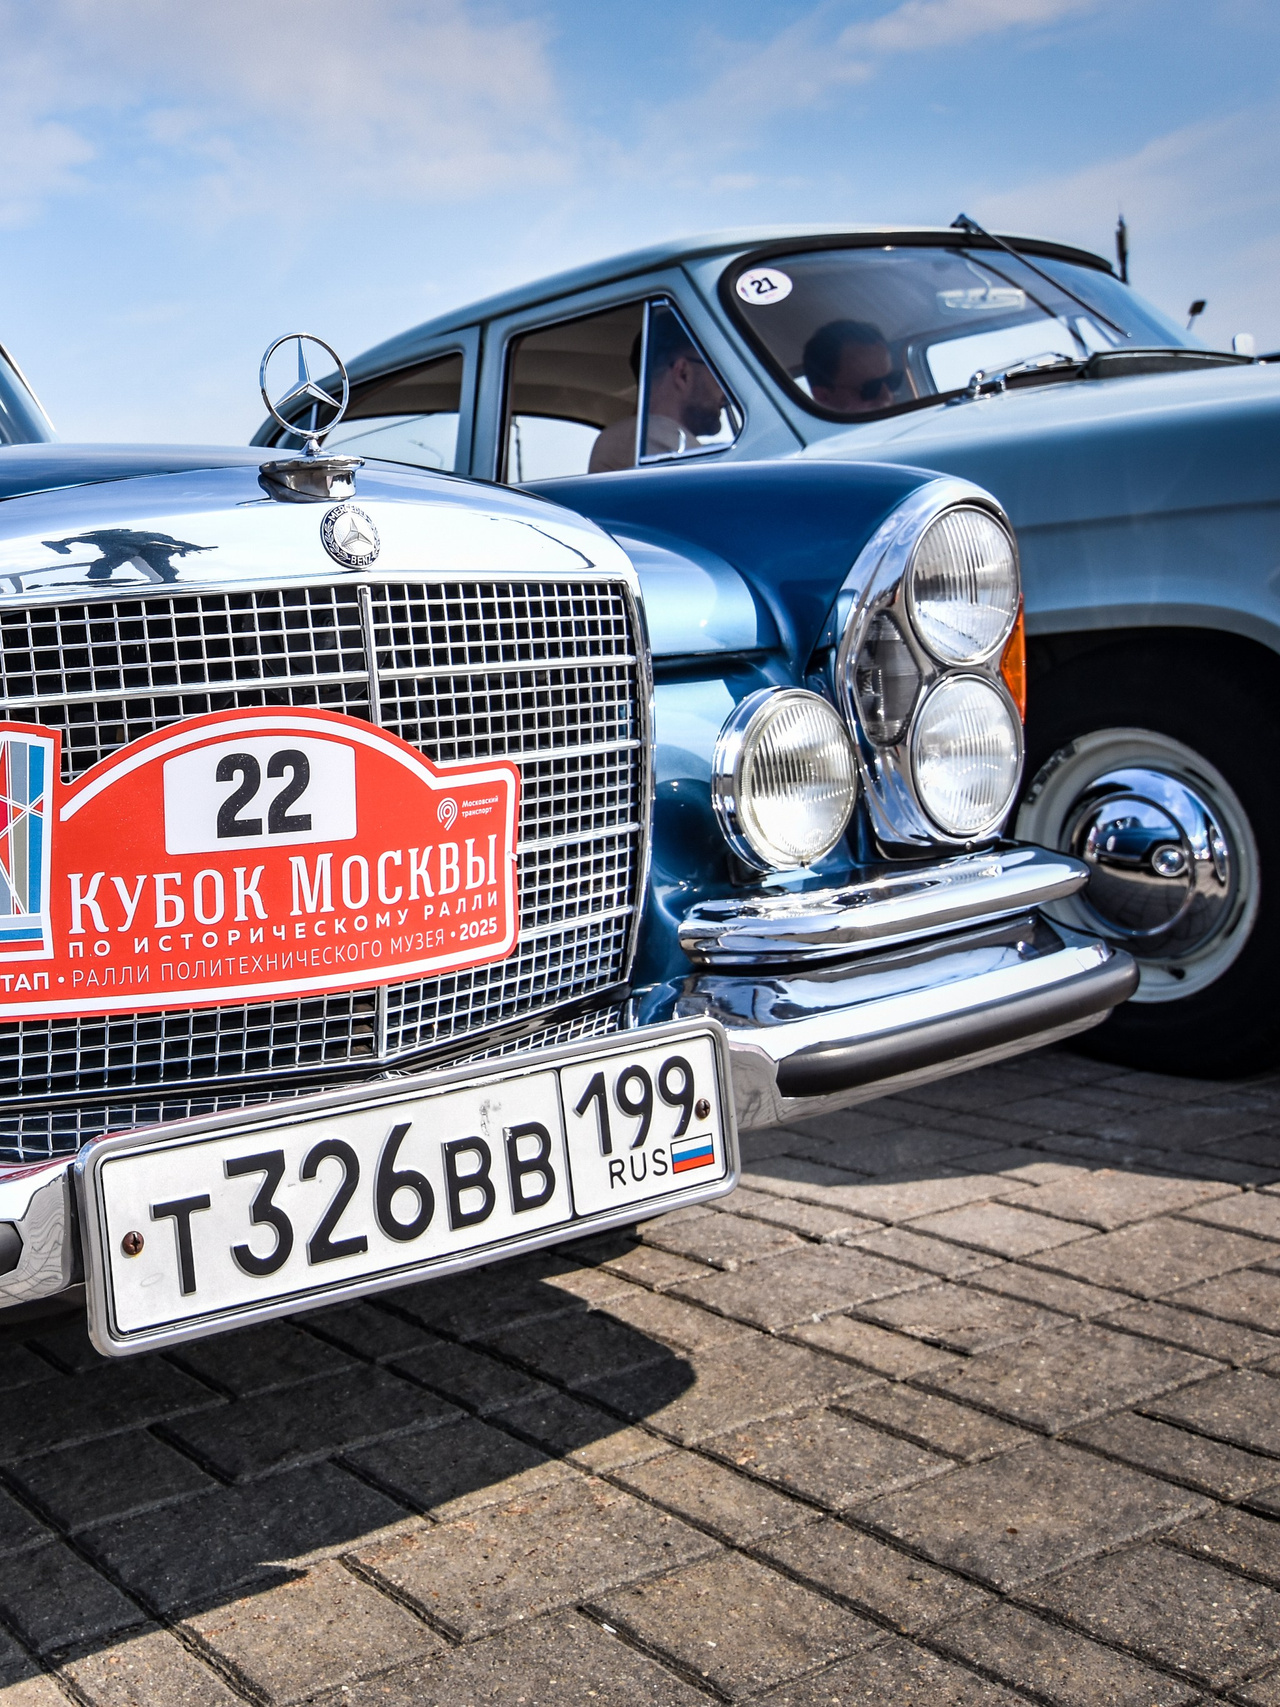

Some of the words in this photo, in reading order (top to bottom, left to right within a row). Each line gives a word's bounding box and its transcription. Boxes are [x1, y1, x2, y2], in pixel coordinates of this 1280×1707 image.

[750, 277, 778, 294] 21
[350, 554, 373, 566] BENZ
[215, 749, 312, 839] 22
[461, 795, 499, 808] Московский
[461, 807, 493, 818] транспорт
[67, 865, 269, 934] КУБОК
[288, 834, 498, 916] МОСКВЫ
[69, 940, 111, 958] ПО
[134, 908, 409, 954] ИСТОРИЧЕСКОМУ
[424, 891, 498, 920] РАЛЛИ
[72, 964, 150, 988] РАЛЛИ
[161, 940, 382, 981] ПОЛИТЕХНИЧЕСКОГО
[390, 929, 444, 955] МУЗЕЯ
[460, 917, 498, 941] 2025
[575, 1055, 697, 1155] 199
[609, 1150, 668, 1189] RUS
